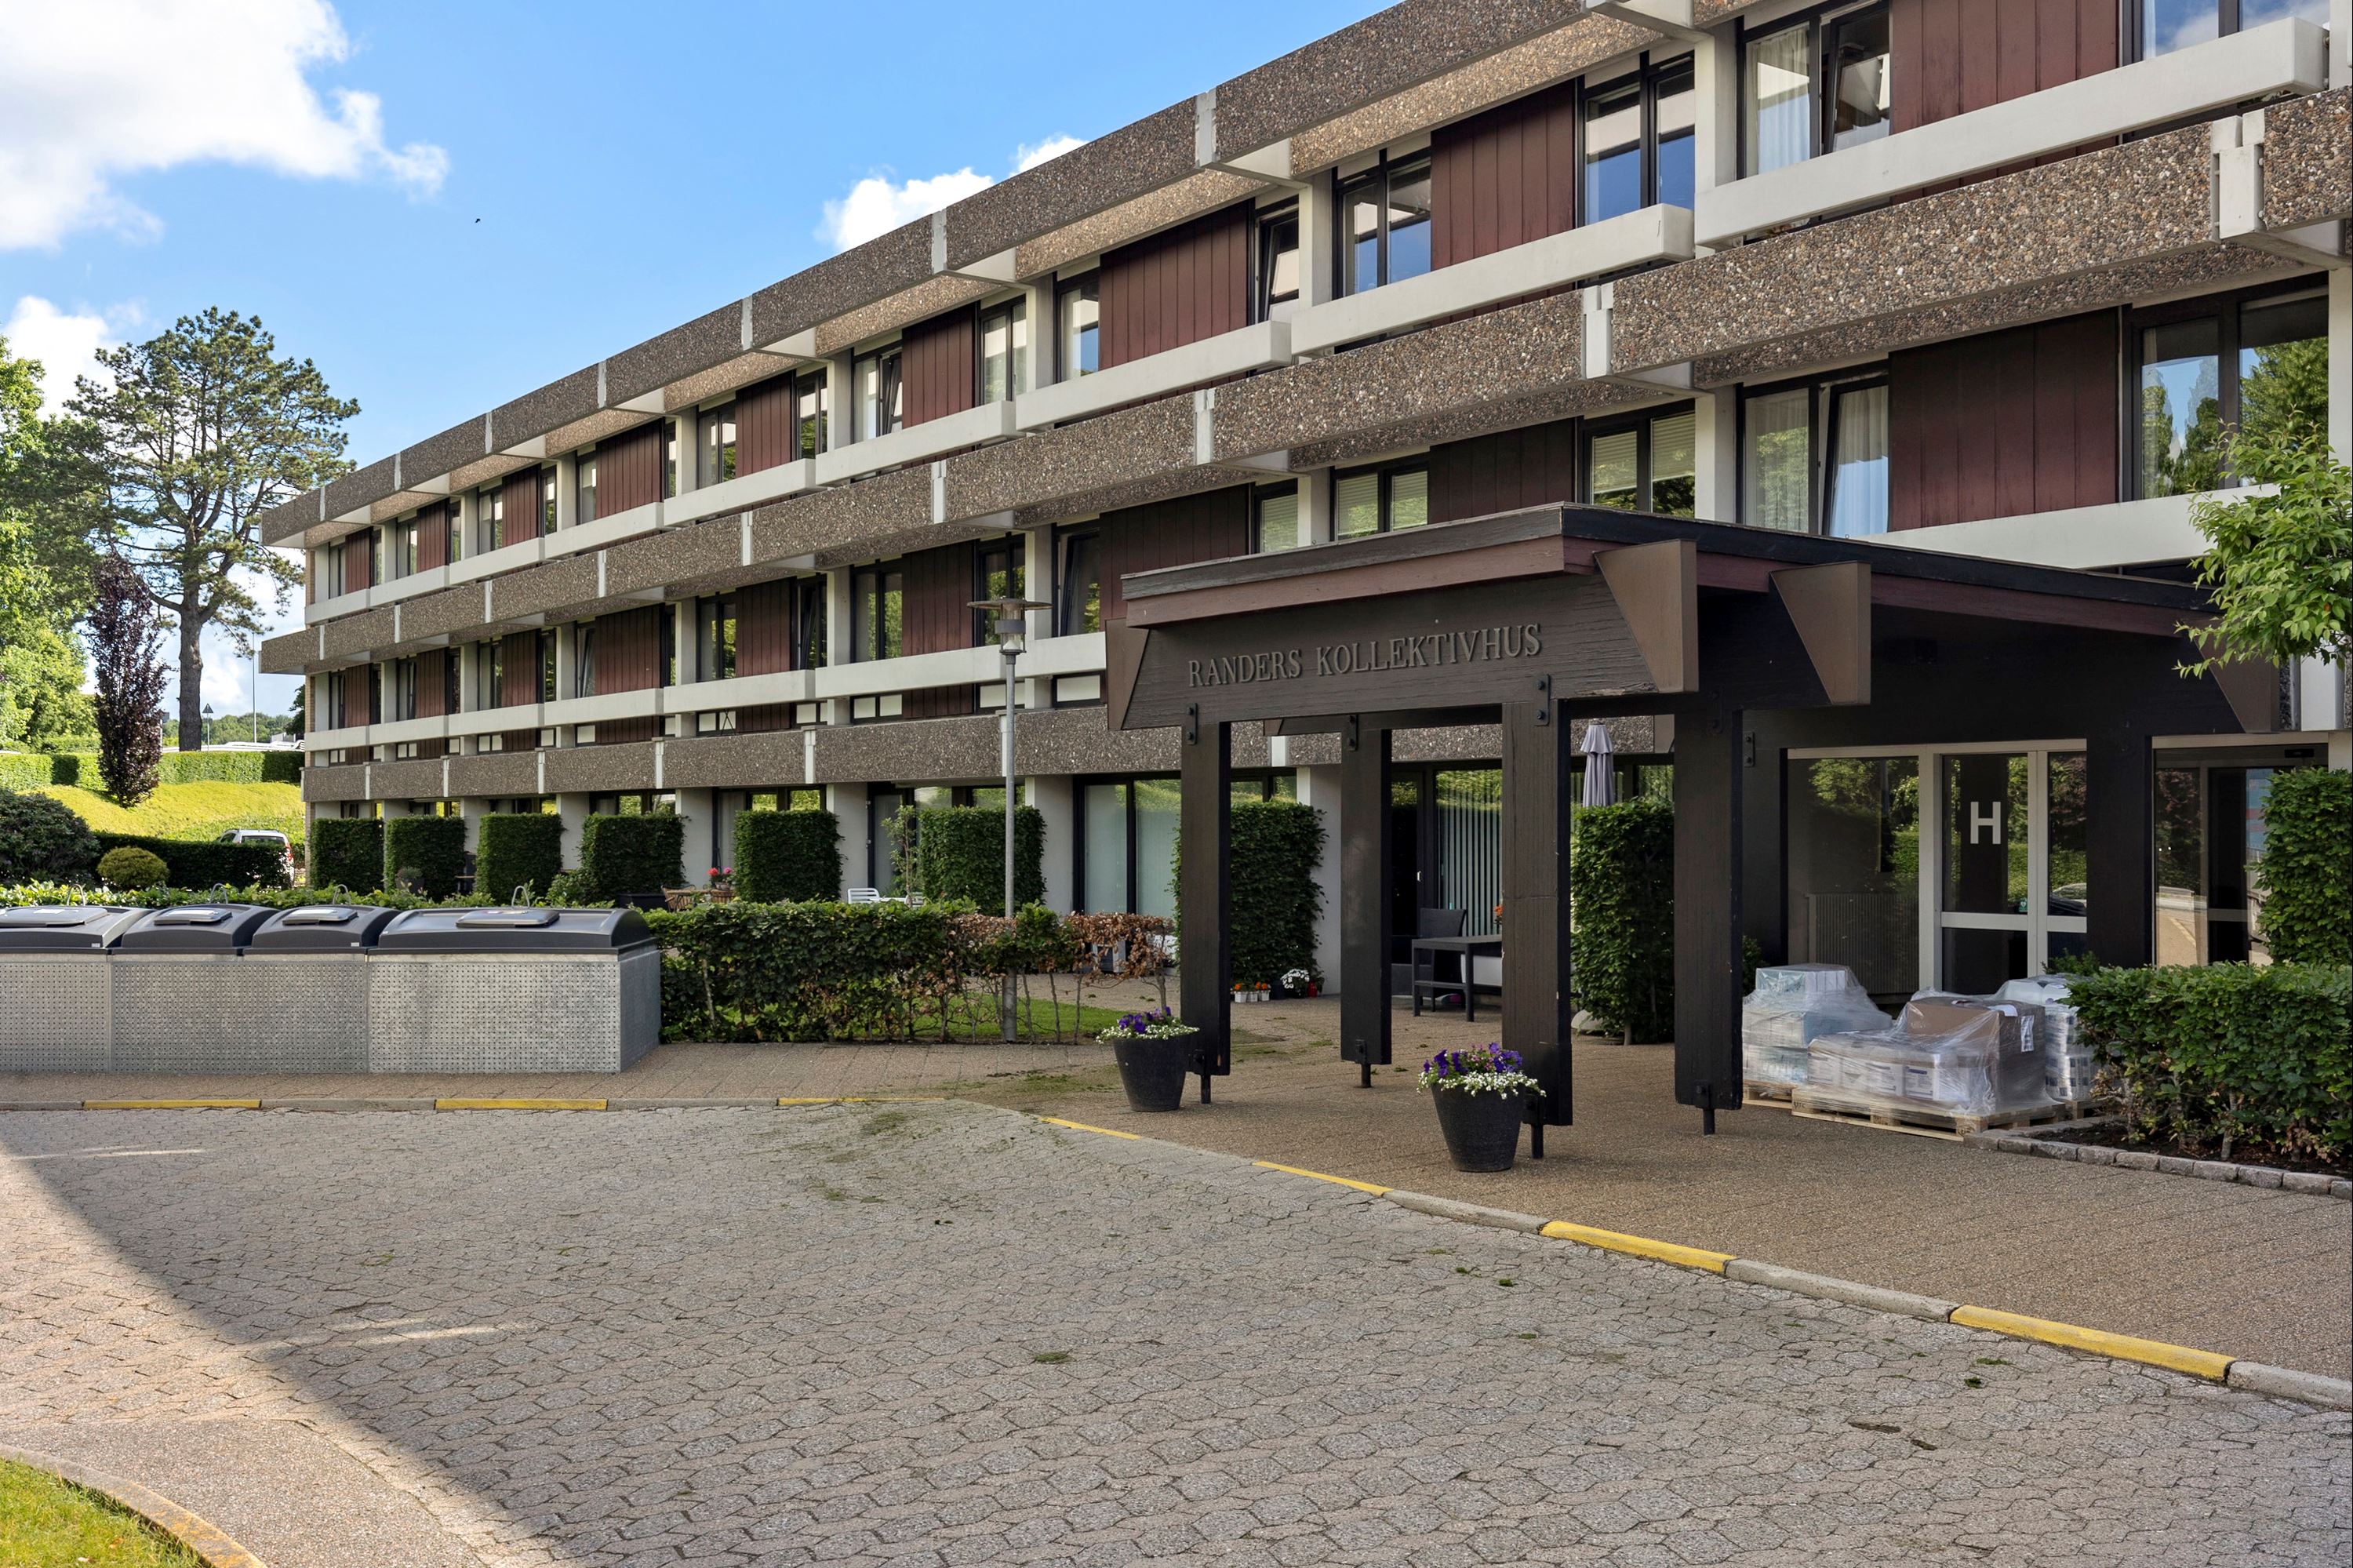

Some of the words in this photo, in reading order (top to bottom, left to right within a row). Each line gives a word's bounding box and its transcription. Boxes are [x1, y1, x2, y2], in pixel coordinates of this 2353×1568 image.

[1188, 649, 1302, 687] RANDERS
[1316, 624, 1541, 676] KOLLEKTIVHUS
[1970, 802, 2001, 845] H
